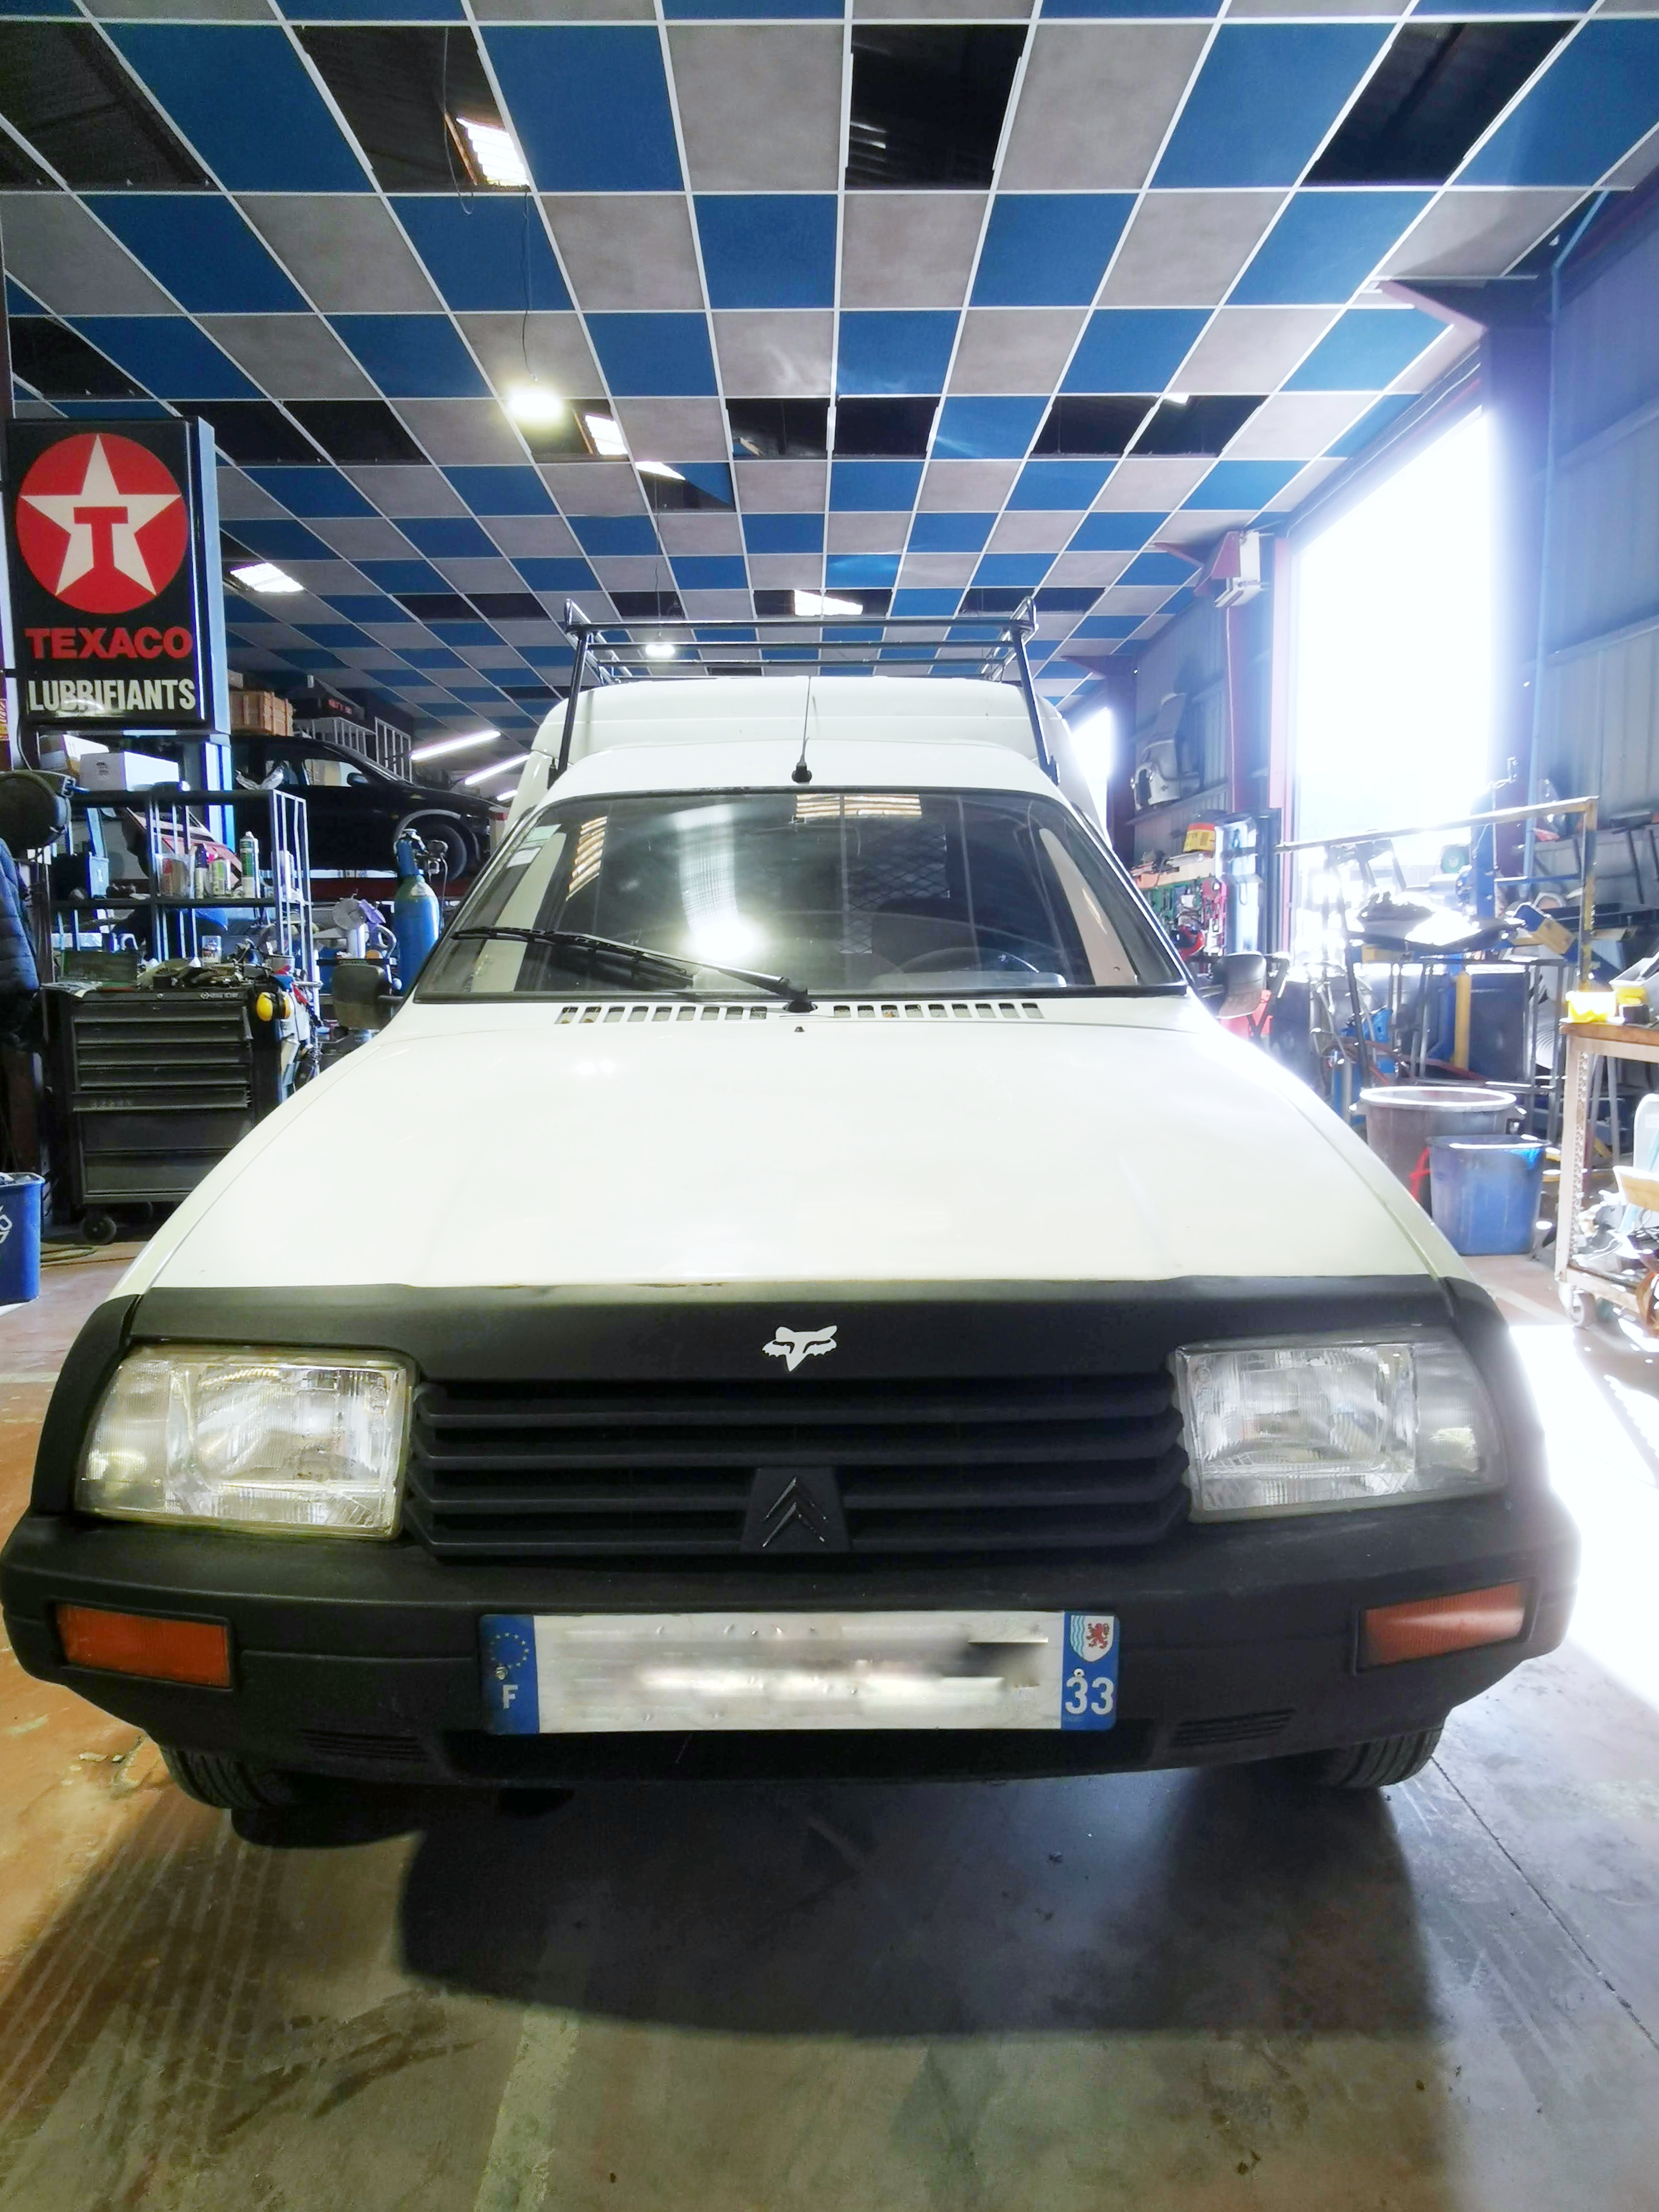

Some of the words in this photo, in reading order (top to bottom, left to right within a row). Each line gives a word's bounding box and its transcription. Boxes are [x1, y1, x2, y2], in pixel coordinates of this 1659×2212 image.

[74, 506, 129, 567] T
[26, 626, 193, 659] TEXACO
[28, 679, 196, 711] LUBRIFIANTS
[503, 1684, 519, 1709] F
[1065, 1677, 1114, 1715] 33
